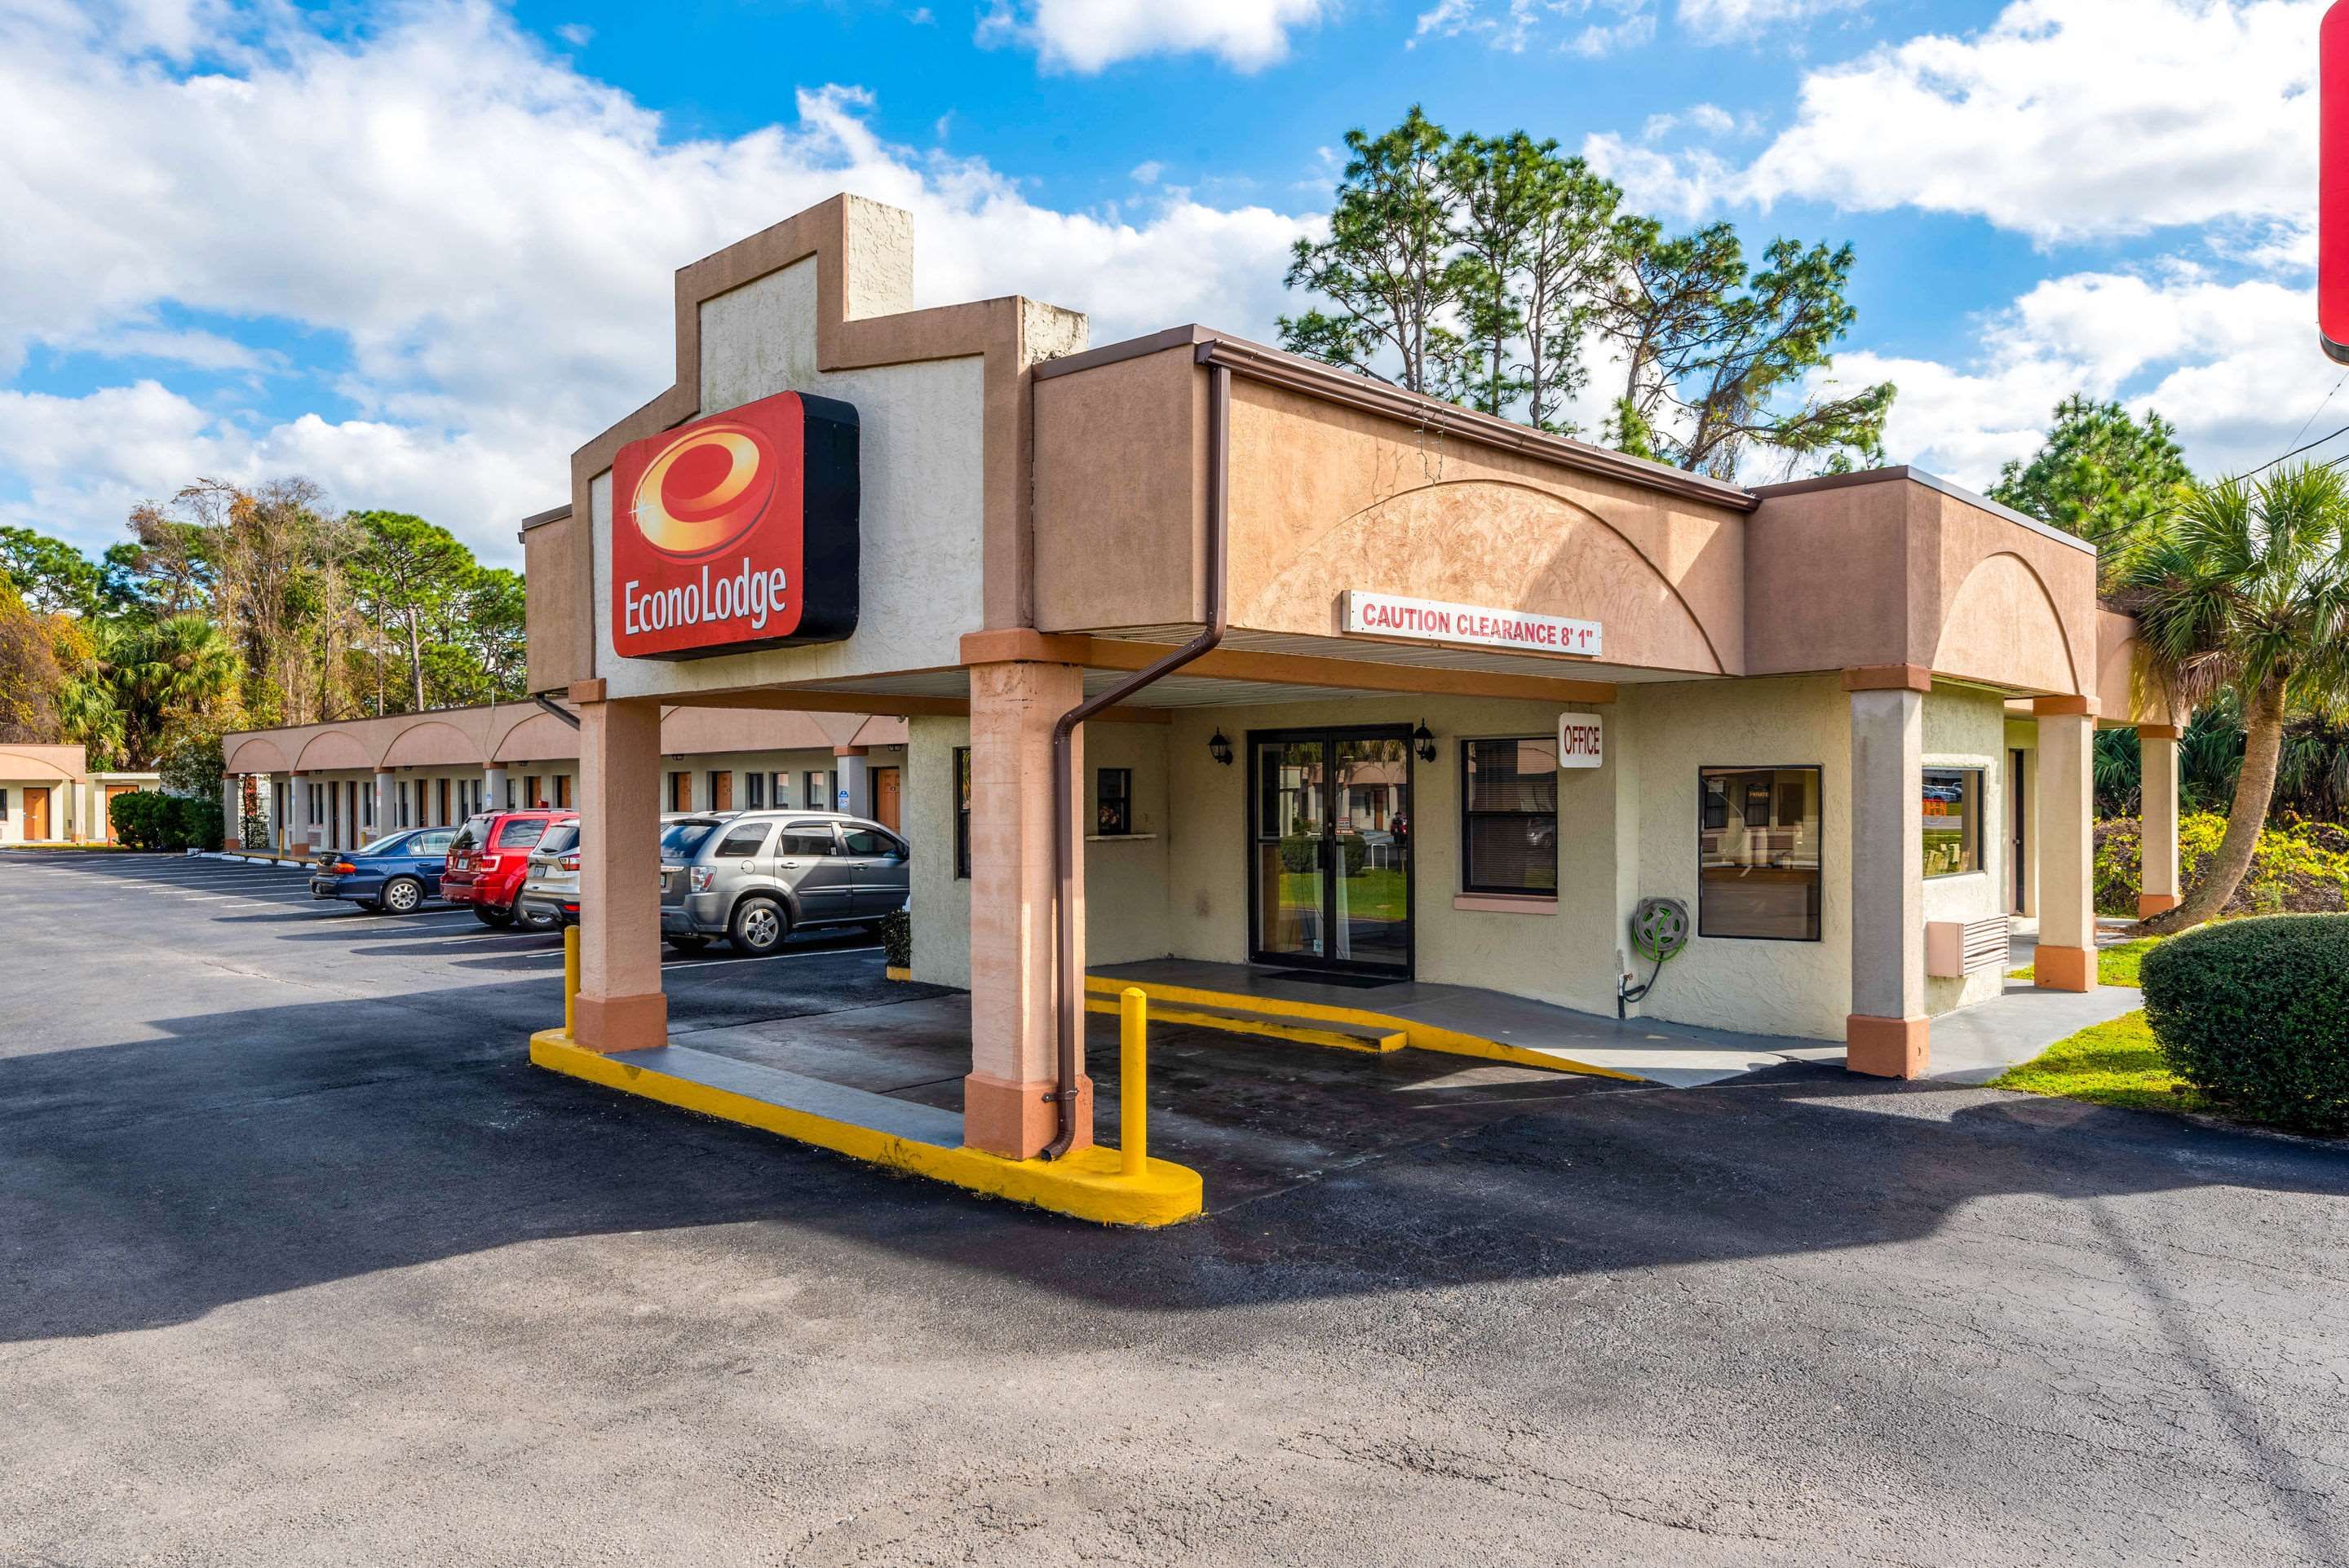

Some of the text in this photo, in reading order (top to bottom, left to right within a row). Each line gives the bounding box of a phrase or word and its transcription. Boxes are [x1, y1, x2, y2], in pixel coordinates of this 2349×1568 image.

[625, 557, 786, 636] EconoLodge
[1363, 603, 1450, 633] CAUTION
[1457, 614, 1556, 645] CLEARANCE
[1561, 626, 1573, 647] 8'
[1564, 725, 1599, 755] OFFICE
